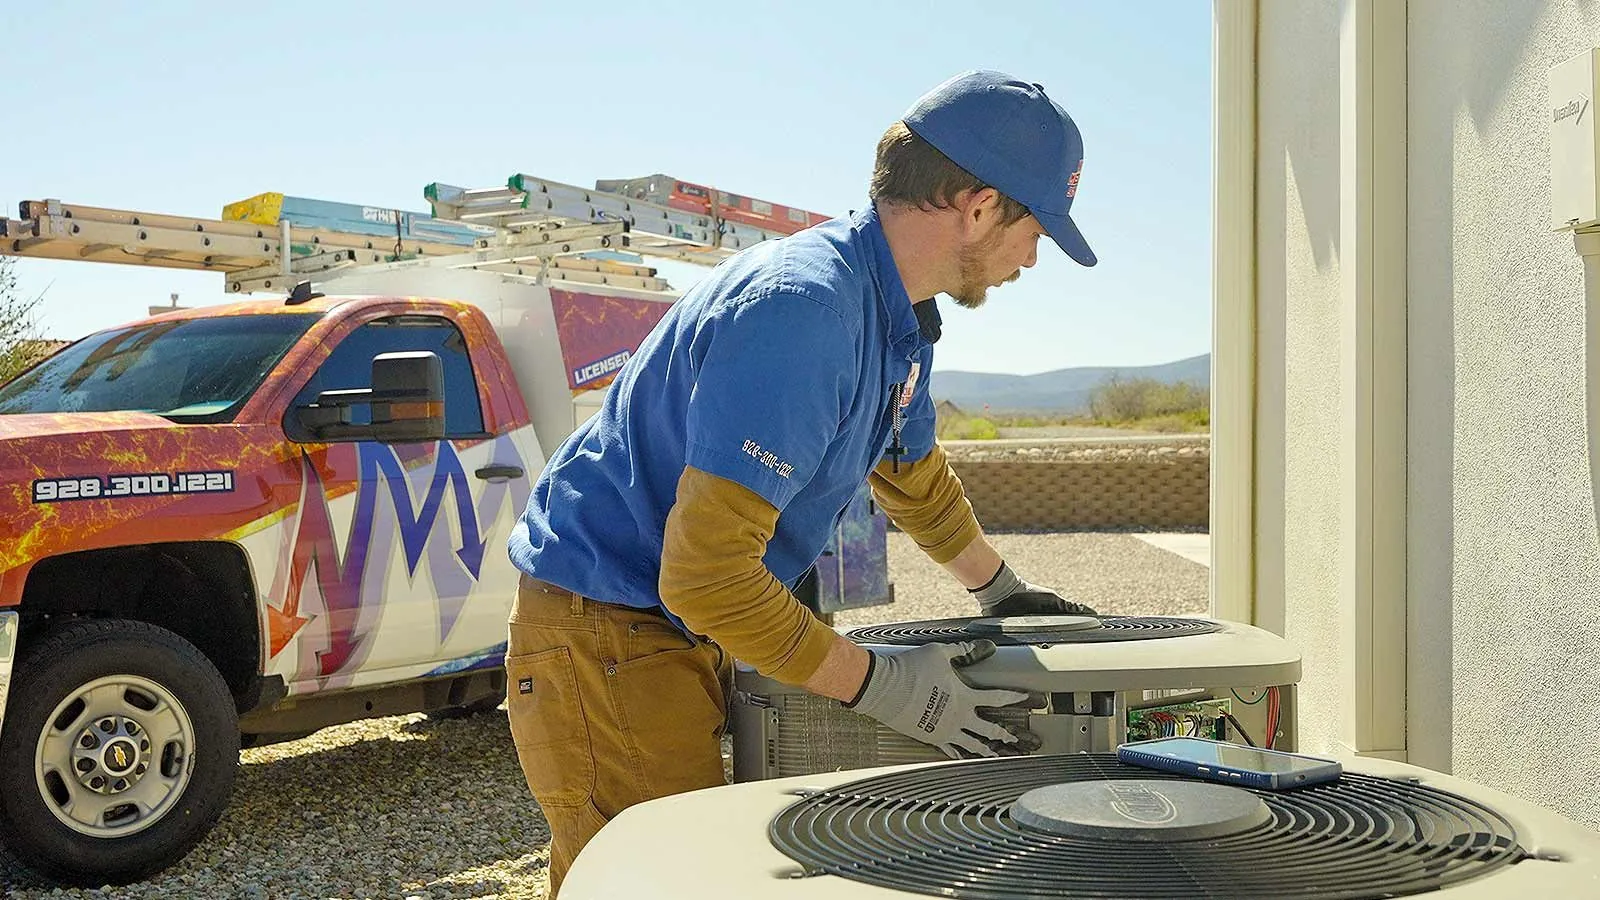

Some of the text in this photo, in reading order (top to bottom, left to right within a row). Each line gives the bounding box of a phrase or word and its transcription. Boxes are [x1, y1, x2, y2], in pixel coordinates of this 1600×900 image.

[574, 350, 630, 385] LICENSED
[35, 472, 232, 500] 928.300.1221
[917, 685, 939, 729] FIRM GRIP
